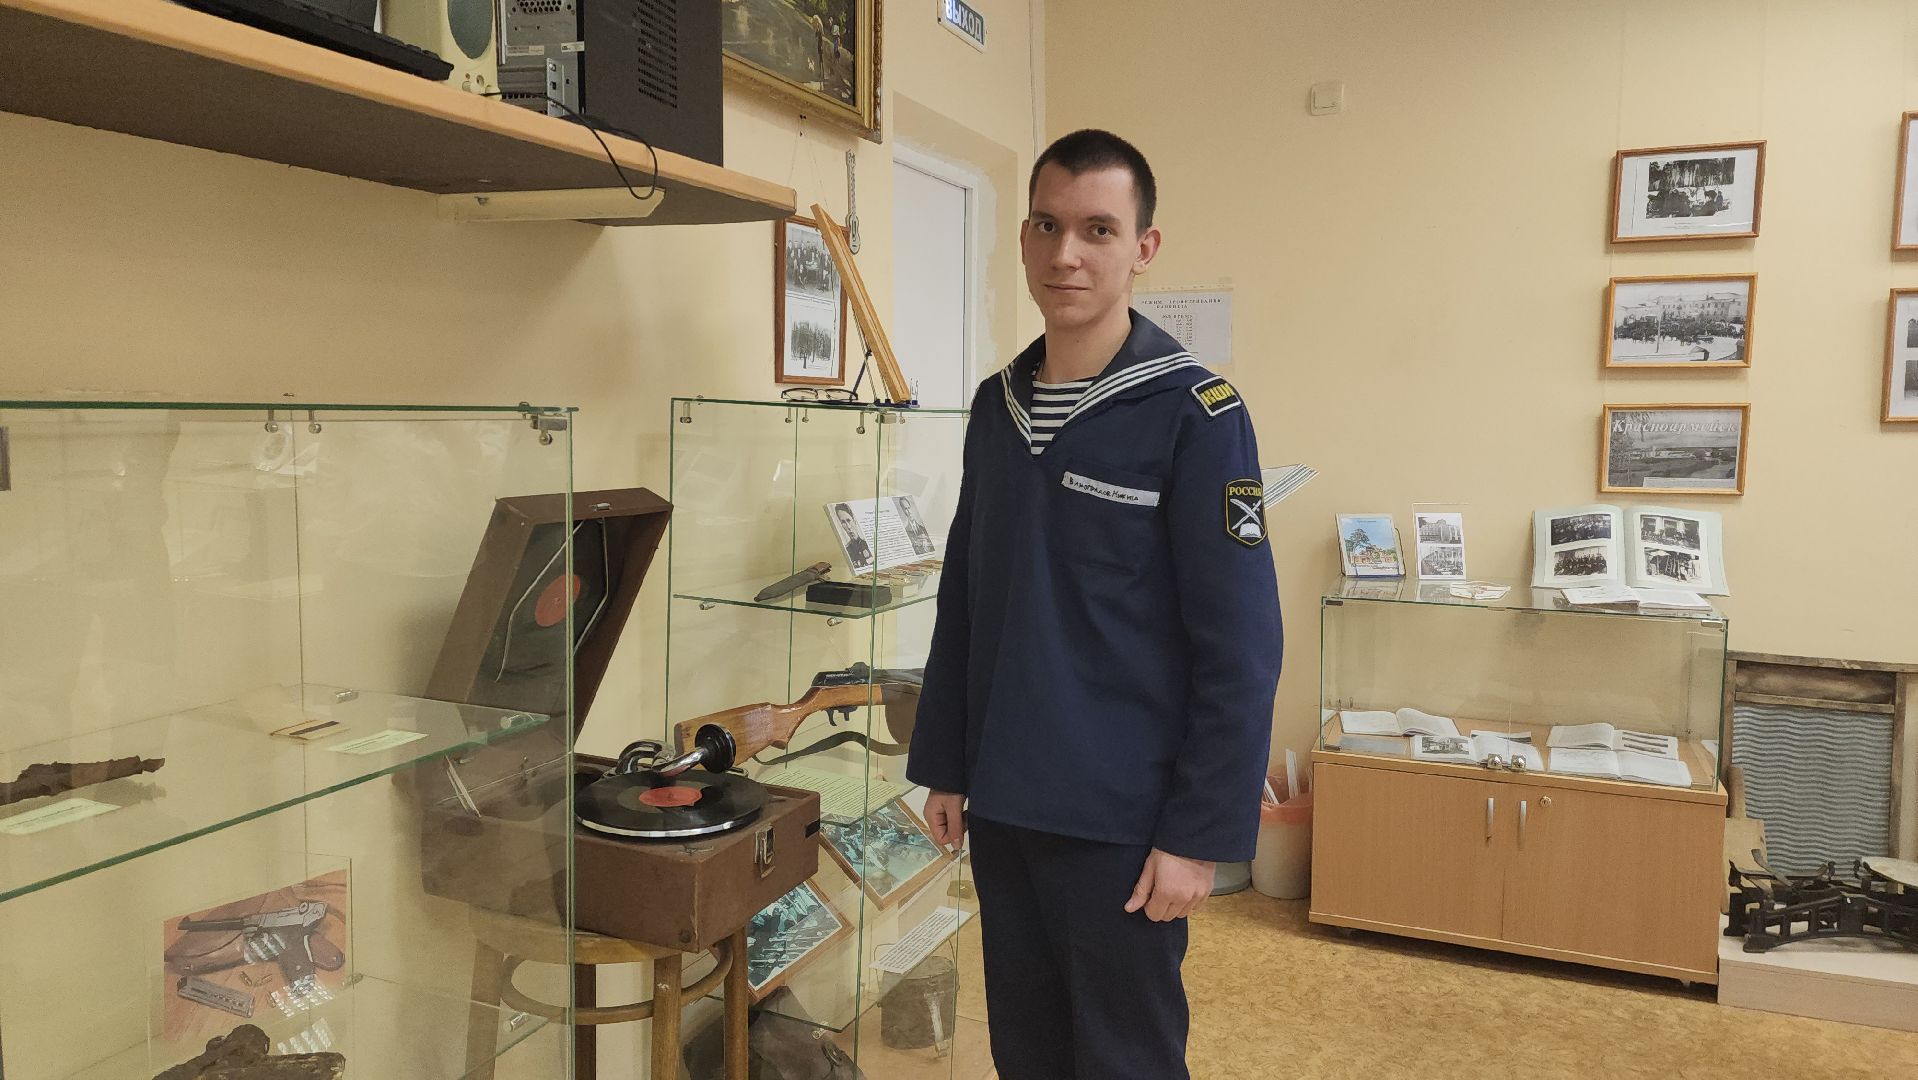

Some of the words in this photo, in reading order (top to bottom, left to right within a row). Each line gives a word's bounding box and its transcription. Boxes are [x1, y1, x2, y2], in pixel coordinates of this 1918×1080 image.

[946, 0, 982, 43] ВЫХОД
[1200, 382, 1236, 406] КШИ
[1612, 419, 1738, 435] Красноармейск
[1228, 486, 1262, 497] РОССИЯ
